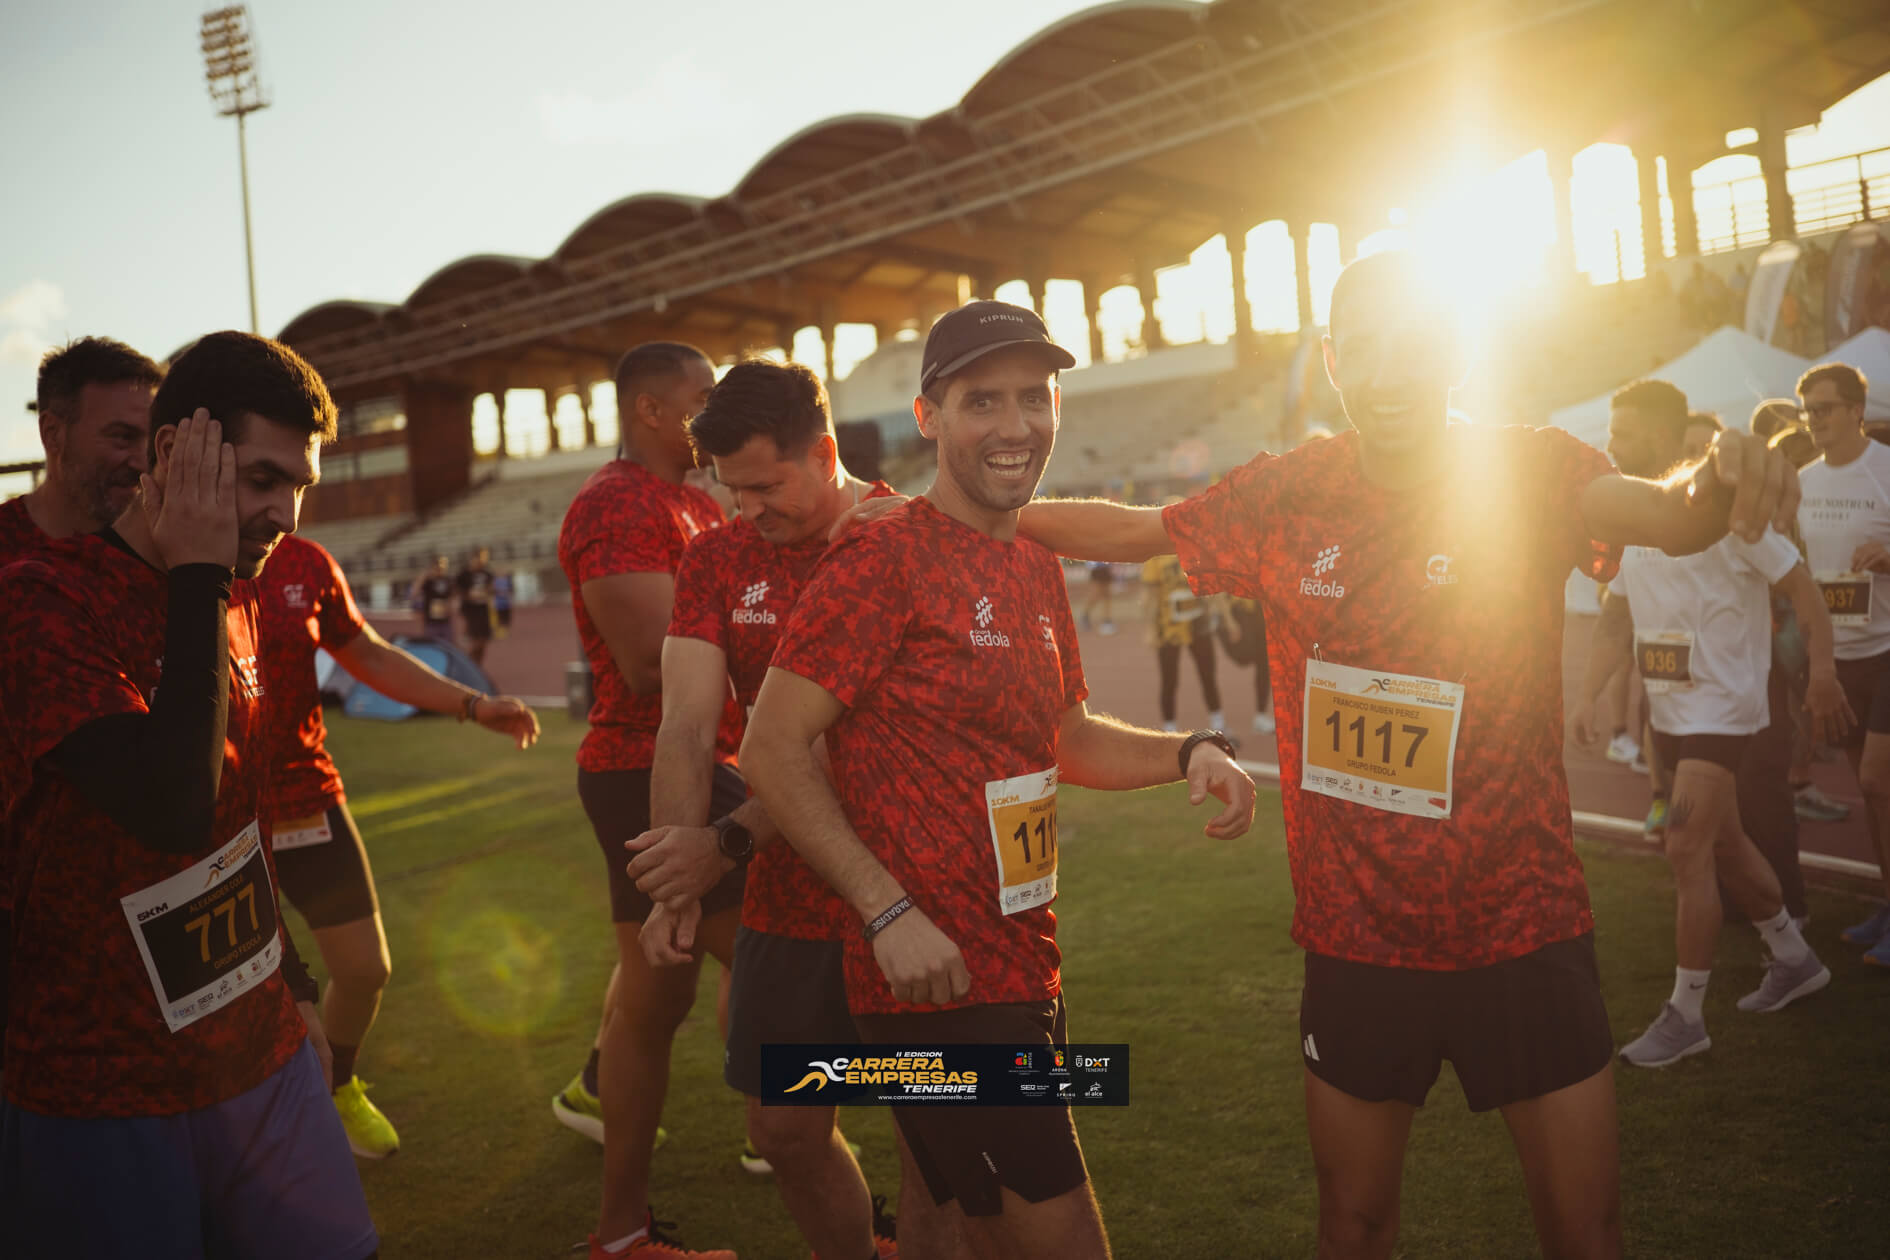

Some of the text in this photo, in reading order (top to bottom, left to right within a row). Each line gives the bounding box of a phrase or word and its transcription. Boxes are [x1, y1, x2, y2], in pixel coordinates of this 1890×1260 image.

[980, 314, 1024, 324] KIPRUN
[1825, 498, 1875, 510] NOSTRUM
[1300, 577, 1345, 598] fedola
[1825, 588, 1856, 609] 937
[732, 608, 776, 625] fedola
[969, 629, 1010, 648] fedola
[1645, 651, 1677, 673] 936
[1332, 696, 1369, 711] FRANCISCO
[1325, 710, 1429, 768] 1117
[1346, 759, 1397, 777] GRUPO FEDOLA
[1014, 812, 1058, 864] 111
[137, 903, 169, 921] 5KM
[184, 882, 259, 963] 777
